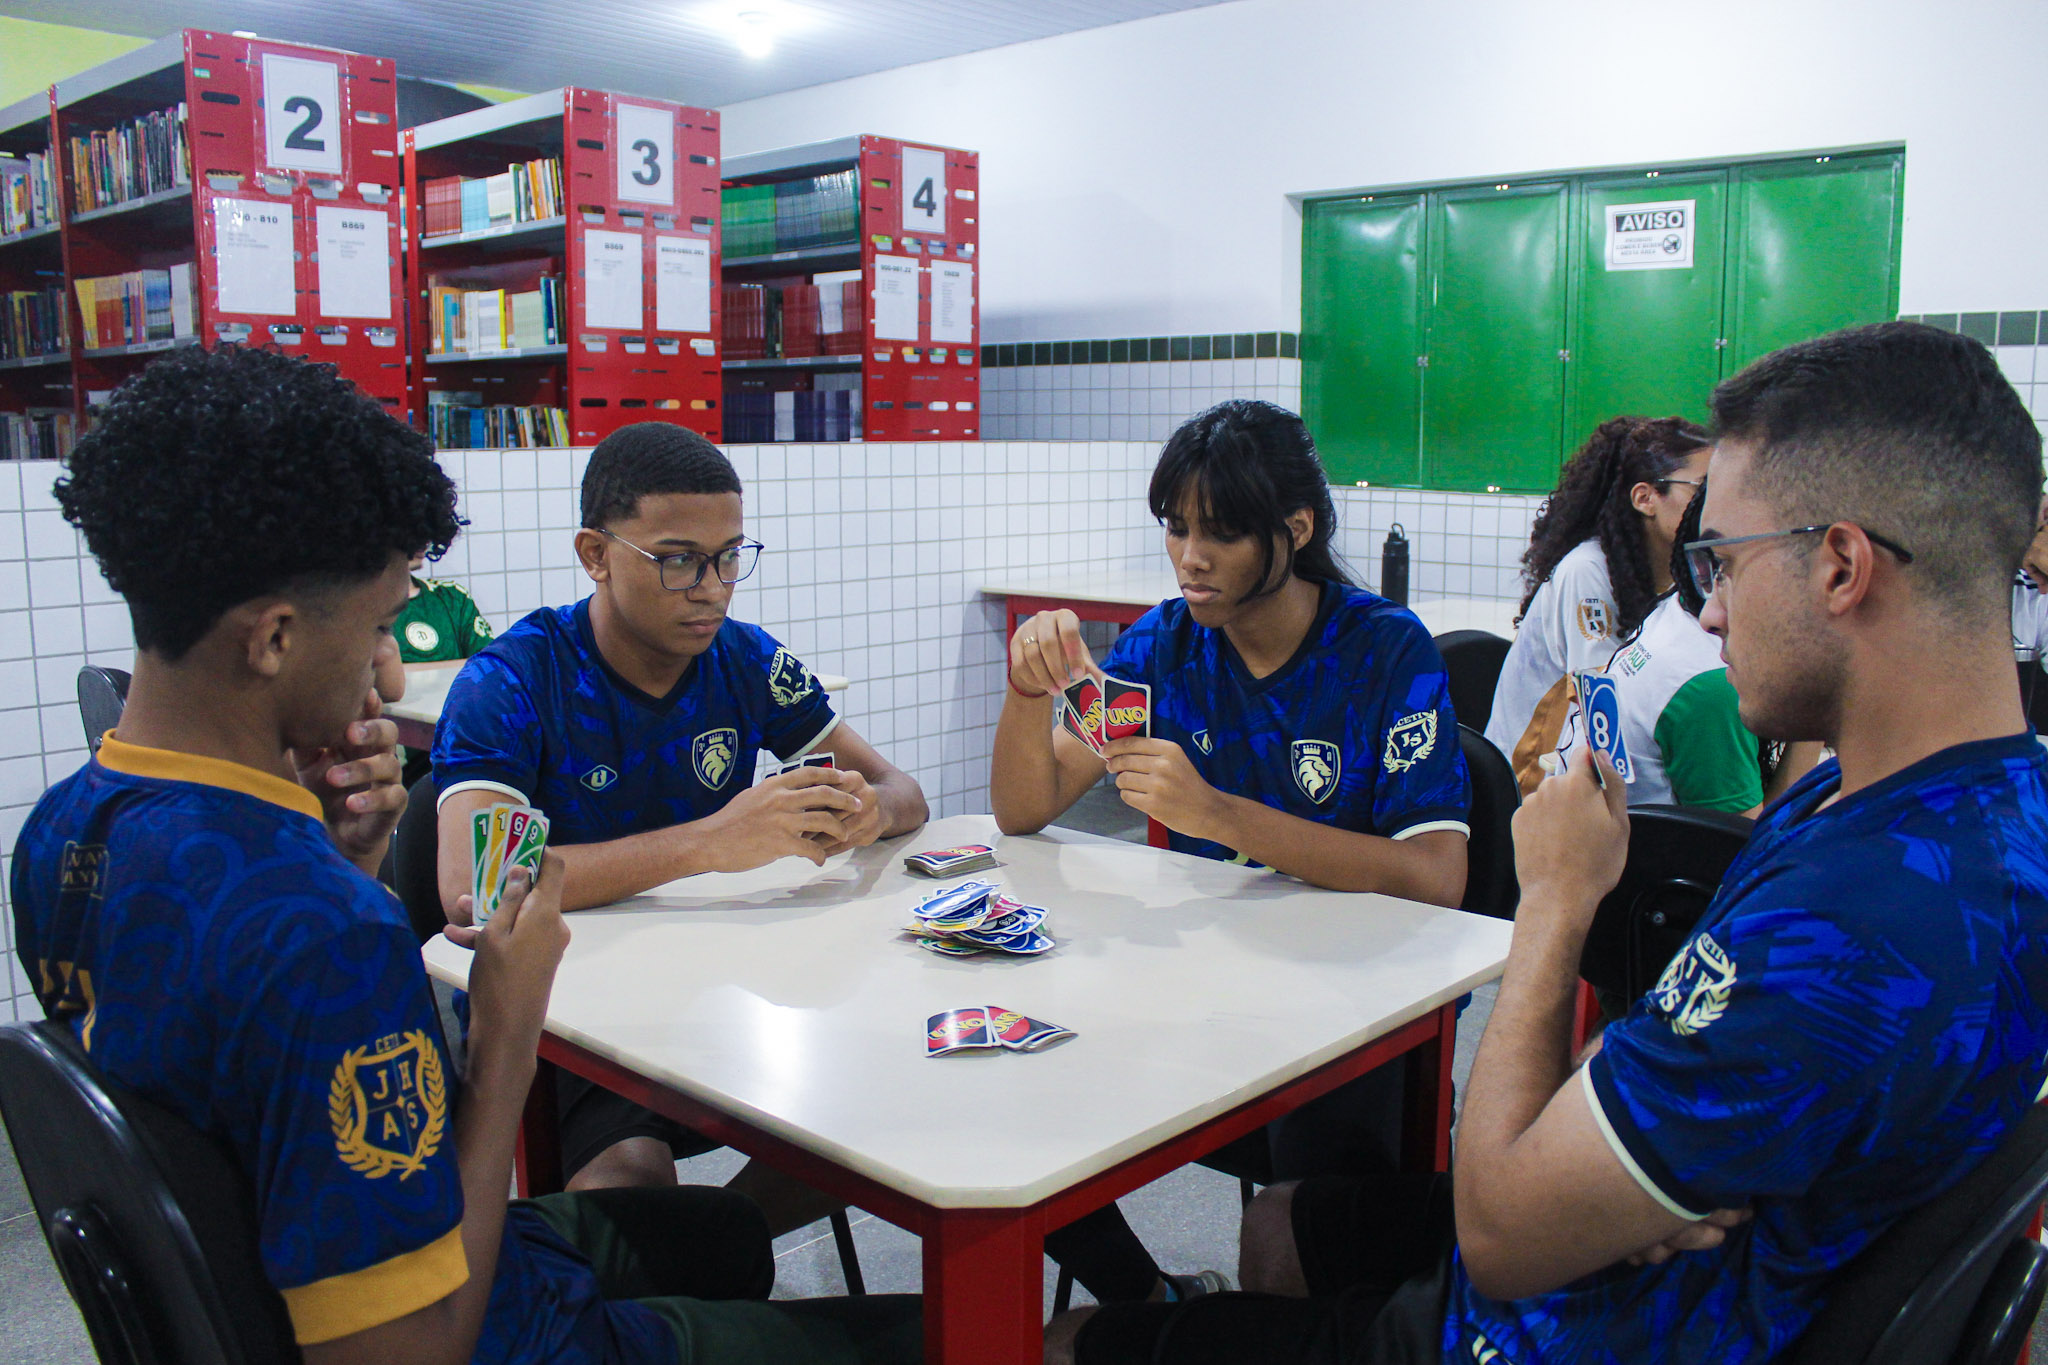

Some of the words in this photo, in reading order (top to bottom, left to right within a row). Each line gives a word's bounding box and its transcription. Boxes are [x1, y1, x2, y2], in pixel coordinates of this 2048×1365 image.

[284, 96, 326, 152] 2
[632, 138, 661, 186] 3
[912, 177, 937, 217] 4
[1620, 211, 1683, 232] AVISO
[1104, 705, 1147, 727] UNO
[1397, 712, 1423, 726] CETI
[1593, 711, 1611, 749] 8
[1615, 758, 1627, 776] 8
[478, 817, 488, 836] 1
[498, 811, 507, 831] 1
[513, 815, 524, 836] 6
[372, 1069, 389, 1100] J
[382, 1111, 401, 1141] A
[406, 1101, 419, 1129] S
